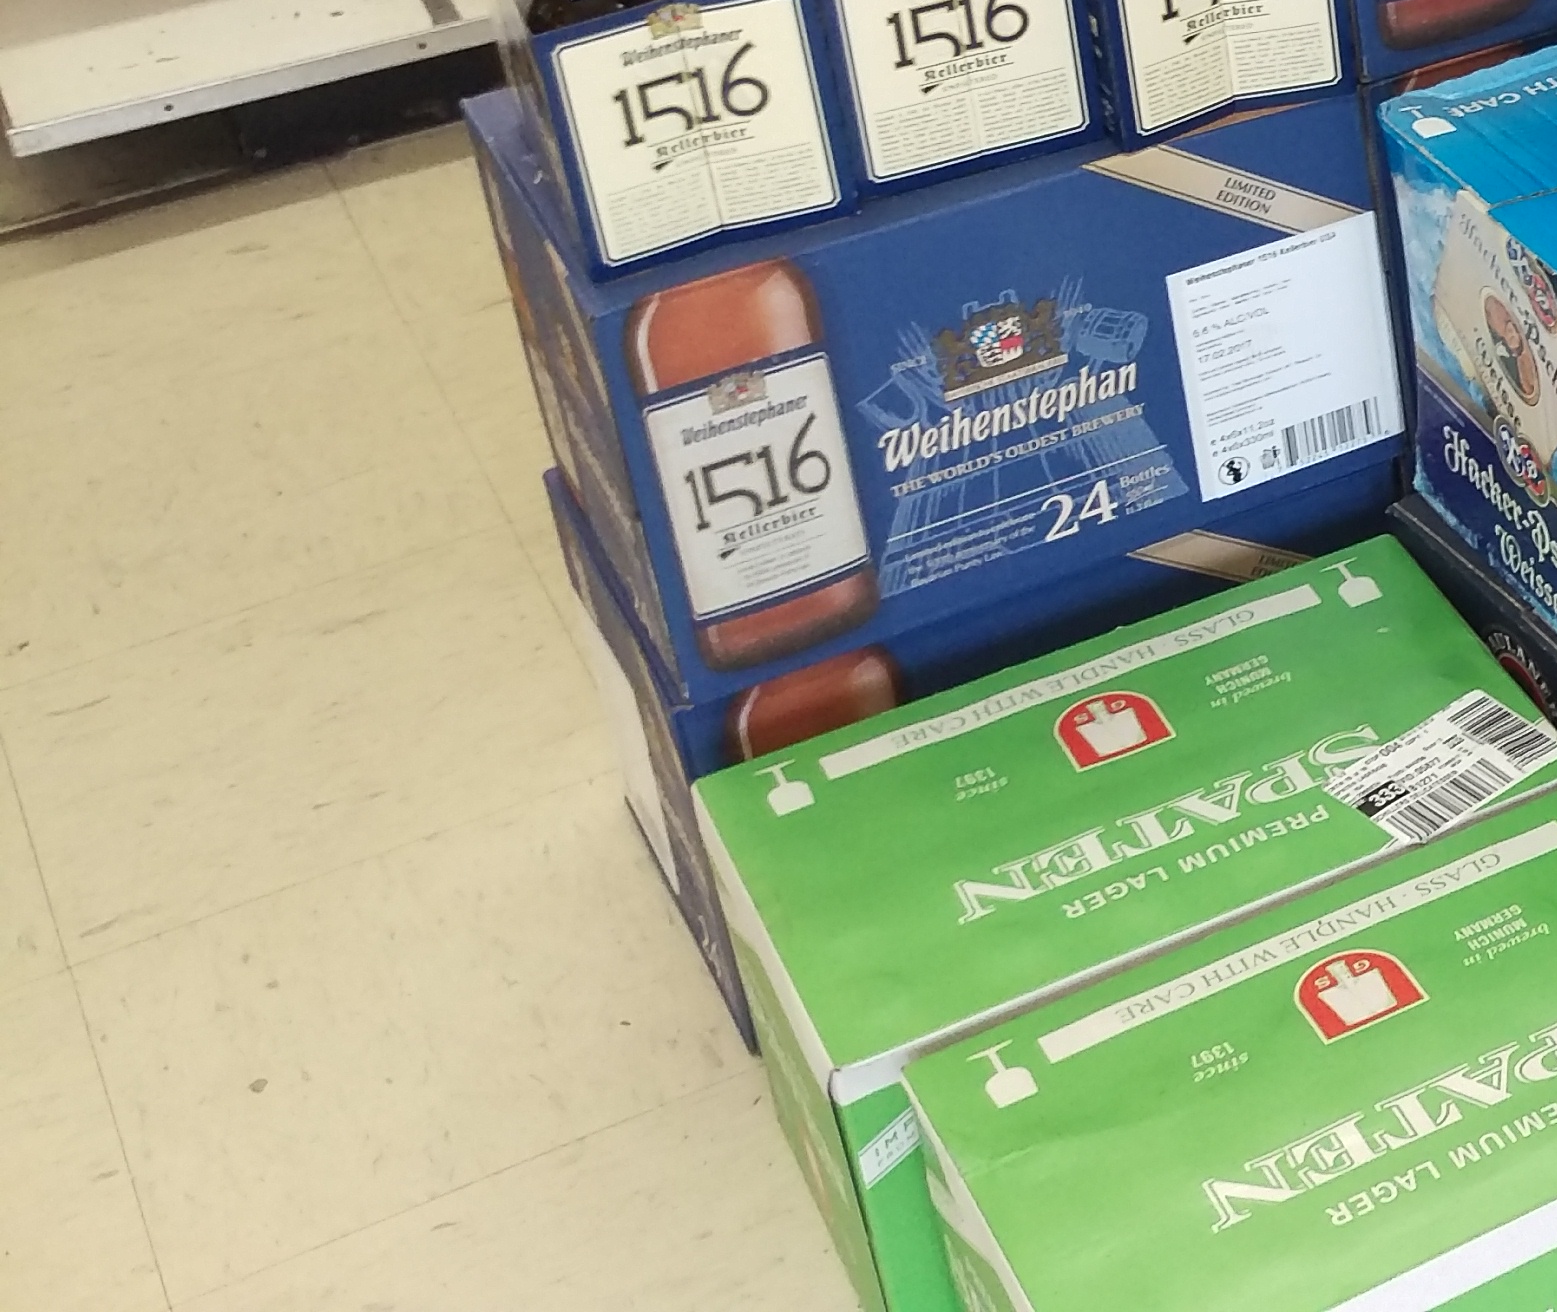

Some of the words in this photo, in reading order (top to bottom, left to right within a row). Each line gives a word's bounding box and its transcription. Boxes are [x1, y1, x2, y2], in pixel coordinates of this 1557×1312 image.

[1185, 3, 1265, 33] Kellerbier
[620, 25, 744, 67] Weihenstephaner
[923, 51, 1008, 82] Kellerbier
[612, 42, 770, 150] 1516
[656, 126, 749, 159] Kellerbier
[1216, 189, 1271, 216] EDITION
[1223, 175, 1276, 202] LIMITED
[679, 393, 808, 448] Weihenstephaner
[878, 362, 1137, 473] Weihenstephan
[1006, 428, 1068, 459] OLDEST
[1072, 403, 1145, 438] BREWERY
[683, 411, 831, 534] 1516
[1041, 479, 1118, 542] 24
[1174, 608, 1256, 647] GLASS
[1041, 645, 1156, 695] HANDLE
[1368, 781, 1406, 808] 333
[952, 723, 1381, 925] SPATEN
[1179, 804, 1330, 874] PREMIUM
[1061, 864, 1170, 920] LAGER
[1414, 852, 1502, 898] GLASS
[1279, 894, 1397, 955] HANDLE
[1454, 904, 1523, 941] GERMANY
[1466, 918, 1528, 952] MUNICH
[1200, 946, 1278, 988] WITH
[1119, 982, 1197, 1025] CARE
[1190, 1041, 1236, 1068] 1397
[1324, 1160, 1441, 1226] LAGER
